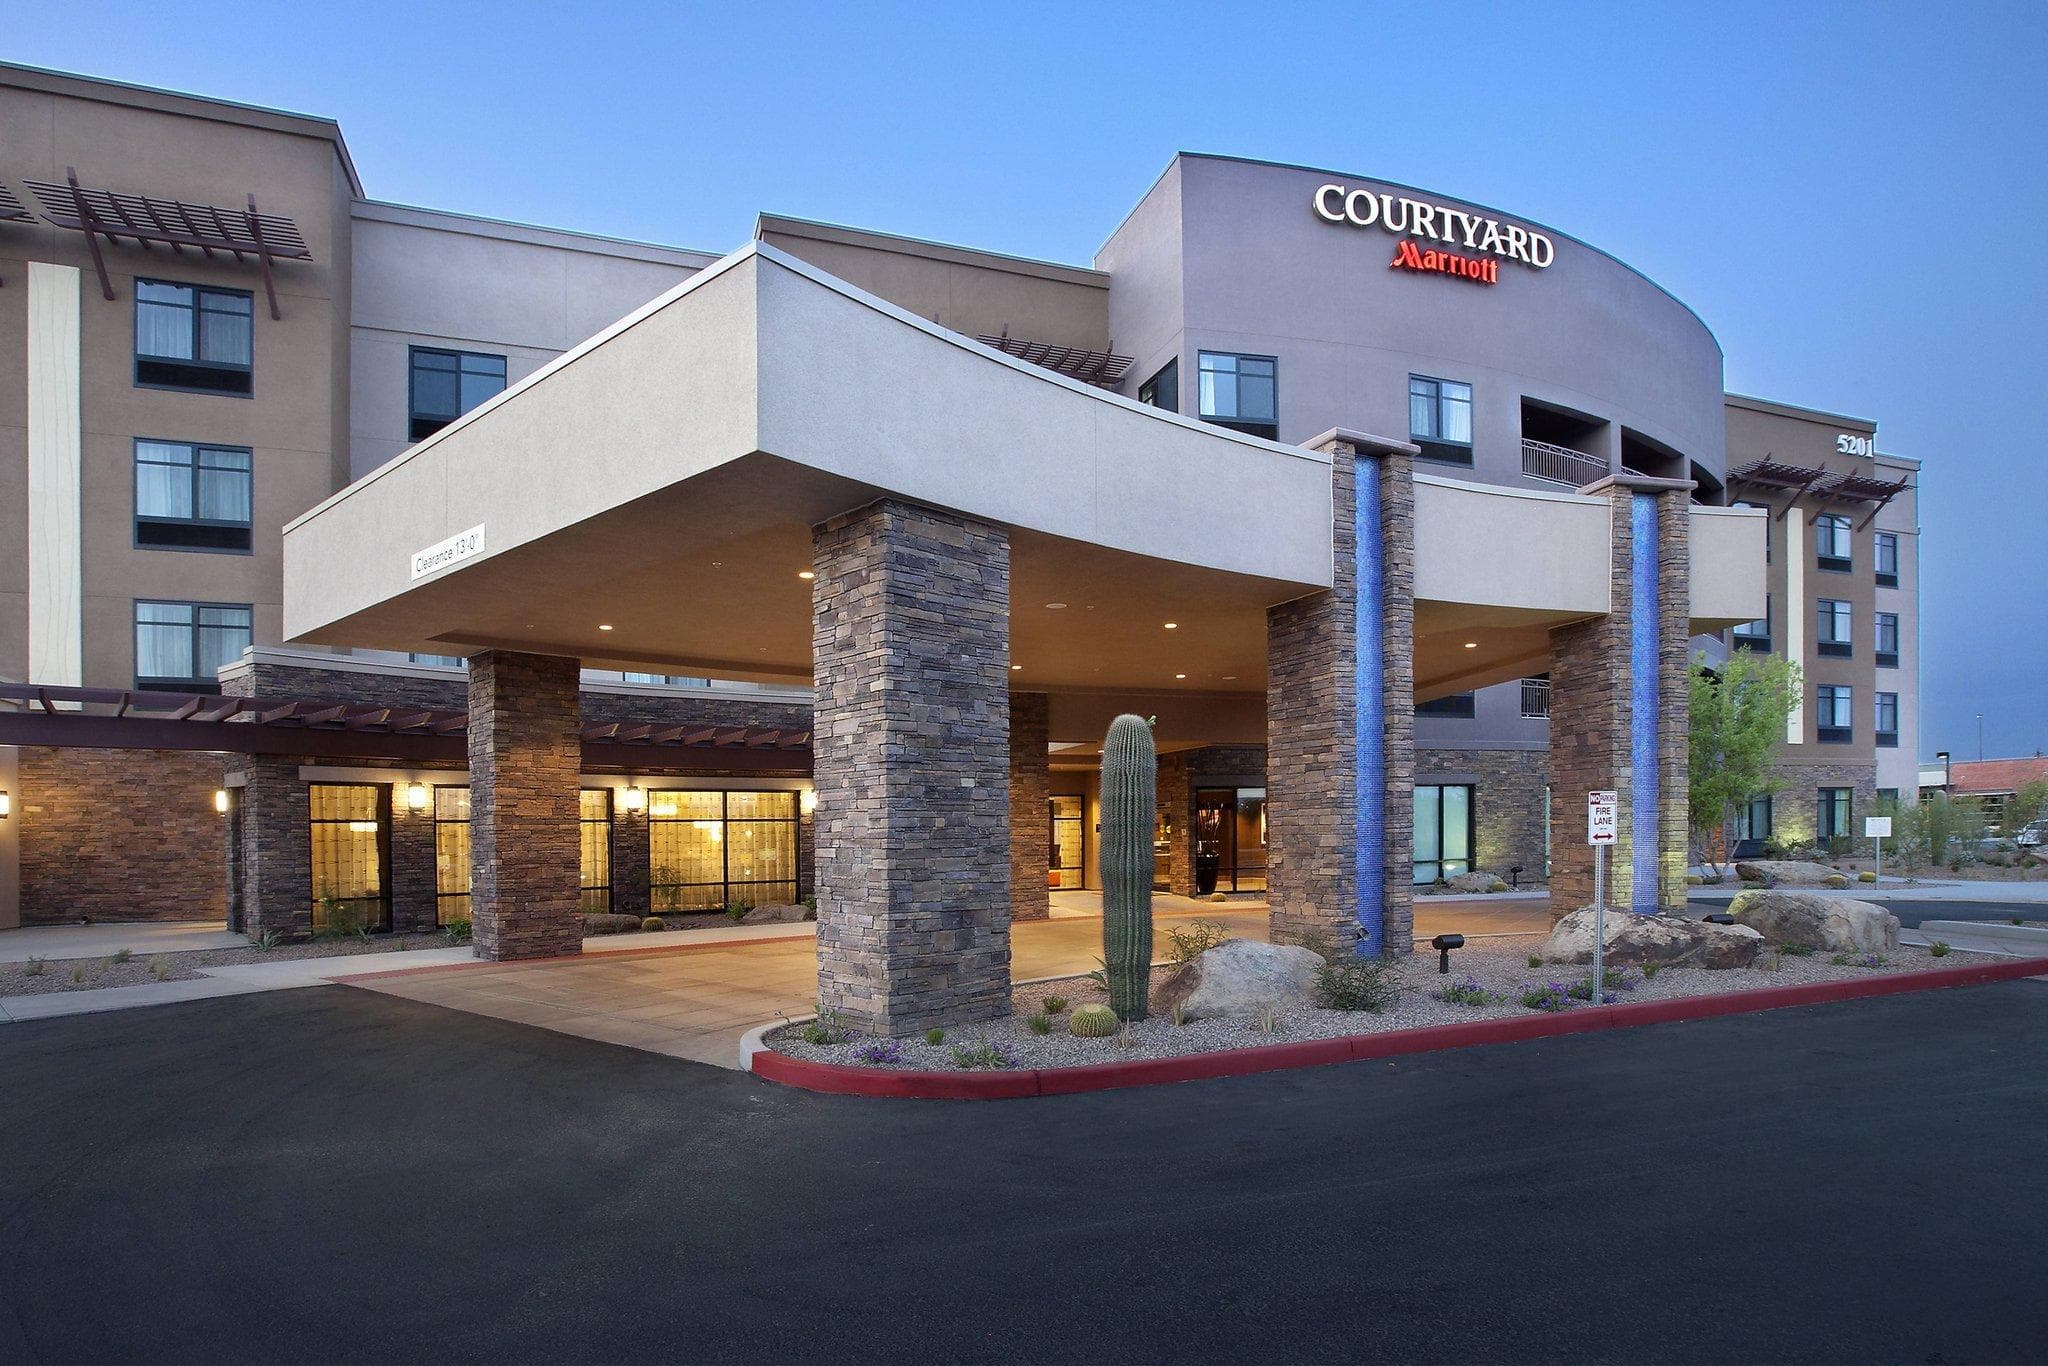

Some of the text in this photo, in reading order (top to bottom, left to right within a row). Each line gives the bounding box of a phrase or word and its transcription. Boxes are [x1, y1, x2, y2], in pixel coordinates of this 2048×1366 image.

[1313, 184, 1555, 269] COURTYARD
[1388, 240, 1498, 284] Marriott
[1836, 434, 1874, 458] 5201
[416, 548, 453, 572] Clearance
[1594, 816, 1613, 825] LANE
[1595, 807, 1612, 815] FIRE
